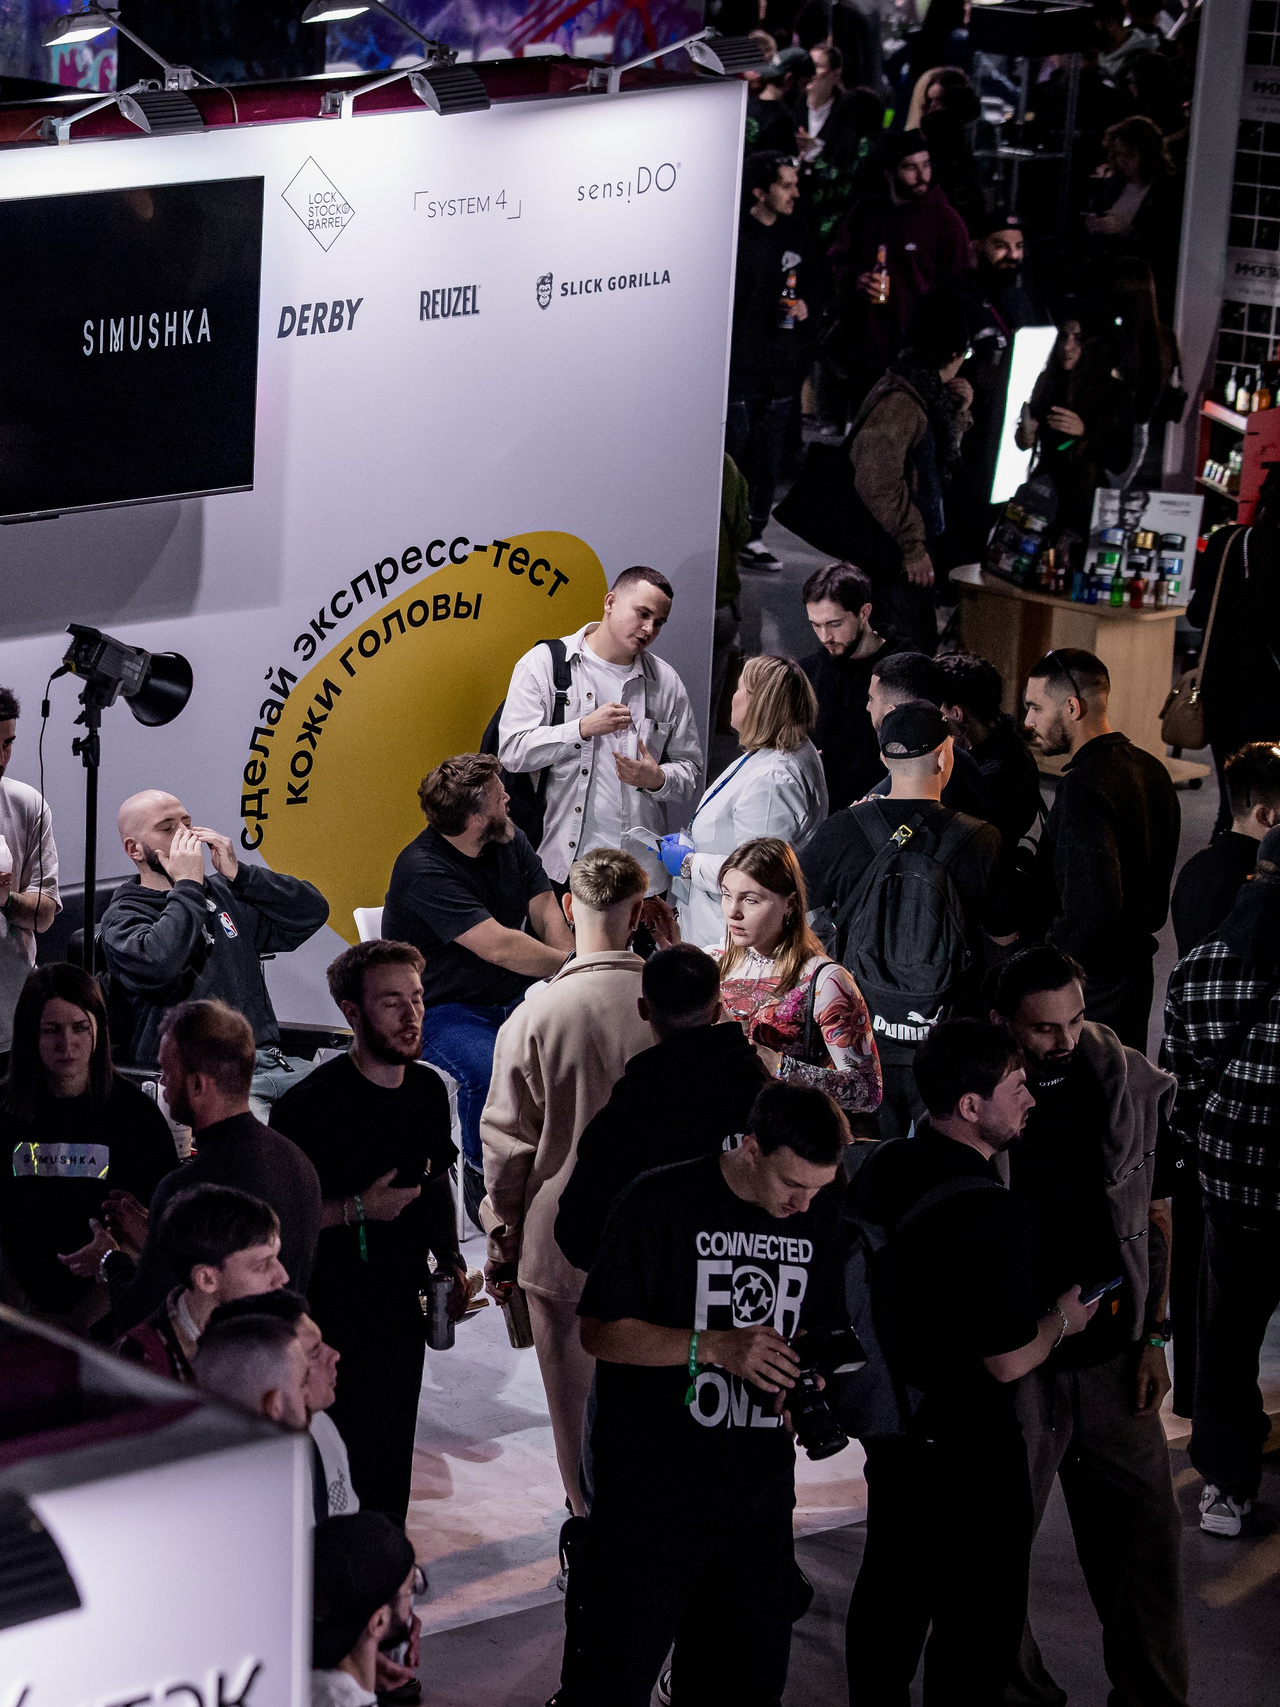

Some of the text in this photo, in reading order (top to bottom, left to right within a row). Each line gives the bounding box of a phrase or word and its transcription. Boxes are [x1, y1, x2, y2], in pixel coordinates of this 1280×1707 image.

[308, 191, 337, 205] LOCK
[427, 189, 507, 218] SYSTEM 4
[308, 216, 346, 231] BARREL
[560, 269, 671, 297] SLICK GORILLA
[420, 284, 480, 321] REUZEL
[82, 308, 211, 356] SIMUSHKA
[277, 297, 364, 339] DERBY
[23, 1154, 97, 1165] SMUSHKA
[695, 1231, 814, 1263] CONNECTED
[694, 1259, 808, 1340] FOR
